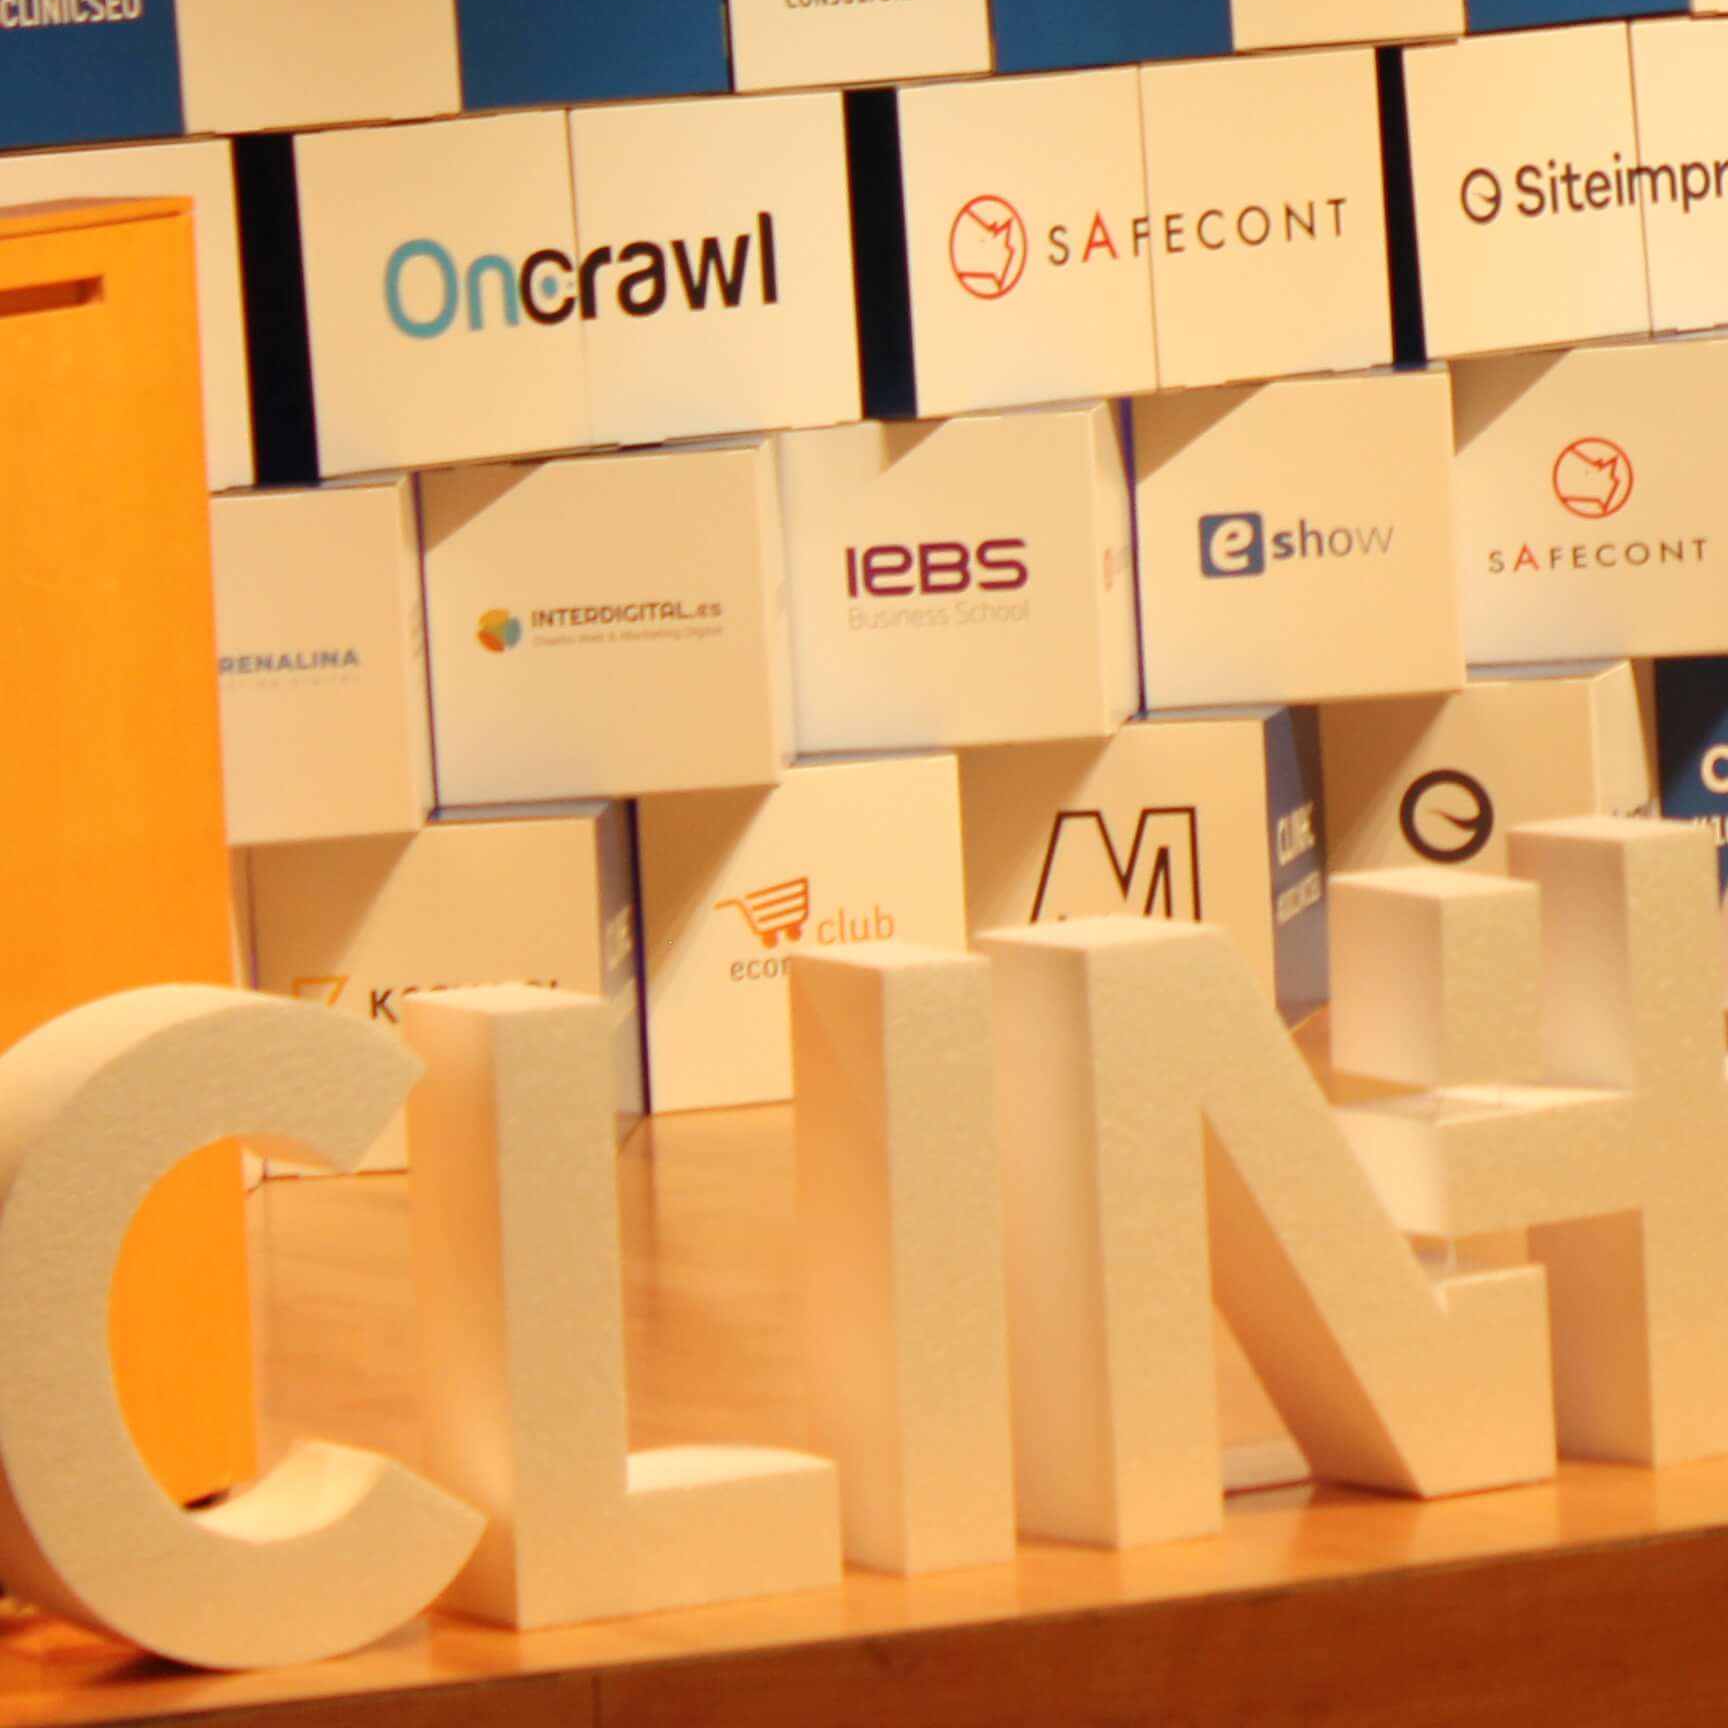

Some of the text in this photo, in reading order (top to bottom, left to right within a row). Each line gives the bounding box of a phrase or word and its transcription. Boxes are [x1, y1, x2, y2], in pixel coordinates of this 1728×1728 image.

[1048, 198, 1348, 267] SAFECONT
[384, 211, 778, 339] Oncrawl
[1488, 538, 1708, 573] SAFECONT
[848, 597, 1030, 631] Business School
[816, 902, 896, 946] club
